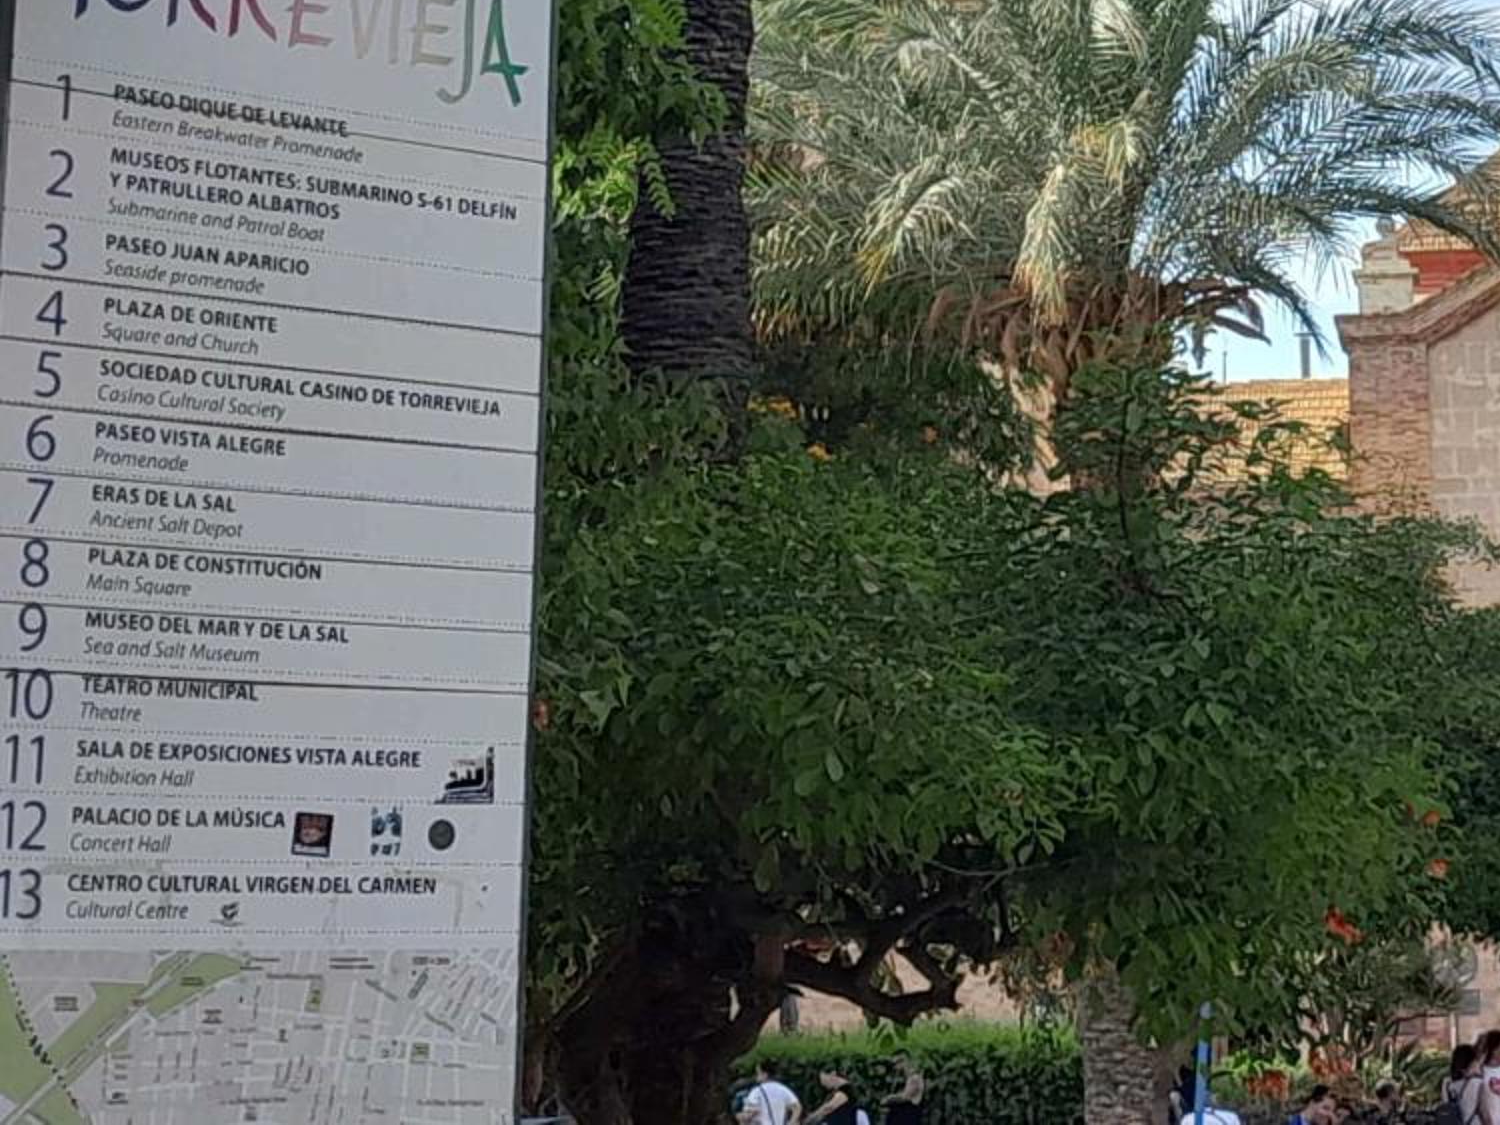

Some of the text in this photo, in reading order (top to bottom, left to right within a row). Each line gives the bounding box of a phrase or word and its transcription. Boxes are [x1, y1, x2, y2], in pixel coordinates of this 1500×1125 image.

[57, 74, 71, 121] 1
[113, 83, 349, 137] PASEO DIQUE DE LEVANTE
[112, 109, 363, 163] Eastern Breakwater Promenade
[46, 149, 73, 198] 2
[110, 147, 517, 220] MUSEOS FLOTANTES: SUBMARINO S-61 DELFÍN
[109, 171, 340, 220] Y PATRULLERO ALBATROS
[107, 196, 325, 241] Submarine and Patrol Boat
[41, 222, 68, 271] 3
[105, 233, 310, 276] PASEO JUAN APARICIO
[104, 258, 265, 295] Seaside promenade
[35, 290, 67, 336] 4
[104, 297, 278, 333] PLAZA DE ORIENTE
[102, 322, 259, 355] Square and Church
[34, 350, 62, 398] 5
[100, 359, 501, 416] SOCIEDAD CULTURAL CASINO DE TORREVIEJA
[97, 383, 286, 422] Casino Cultural Society
[25, 414, 56, 461] 6
[95, 421, 286, 456] PASEO VISTA ALEGRE
[92, 447, 189, 472] Promenade
[27, 477, 54, 524] 7
[92, 484, 236, 513] ERAS DE LA SAL
[89, 510, 243, 540] Ancient Salt Depot
[20, 537, 49, 587] 8
[88, 547, 322, 580] PLAZA DE CONSTITUCIÓN
[86, 573, 192, 597] Main Square
[18, 601, 47, 652] 9
[85, 611, 349, 643] MUSEO DEL MAR Y DE LA SAL
[83, 636, 260, 663] Sea and Salt Museum
[3, 668, 53, 720] 10
[81, 675, 259, 701] TEATRO MUNICIPAL
[79, 701, 142, 723] Theatre
[5, 734, 45, 784] 11
[76, 739, 421, 768] SALA DE EXPOSICIONES VISTA ALEGRE
[74, 765, 195, 787] Exhibition Hall
[1, 800, 47, 851] 12
[72, 806, 286, 828] PALACIO DE LA MÚSICA
[69, 832, 172, 853] Concert Hall
[0, 868, 42, 919] 13
[67, 874, 437, 894] CENTRO CULTURAL VIRGEN DEL CARMEN
[65, 900, 190, 920] Cultural Centre
